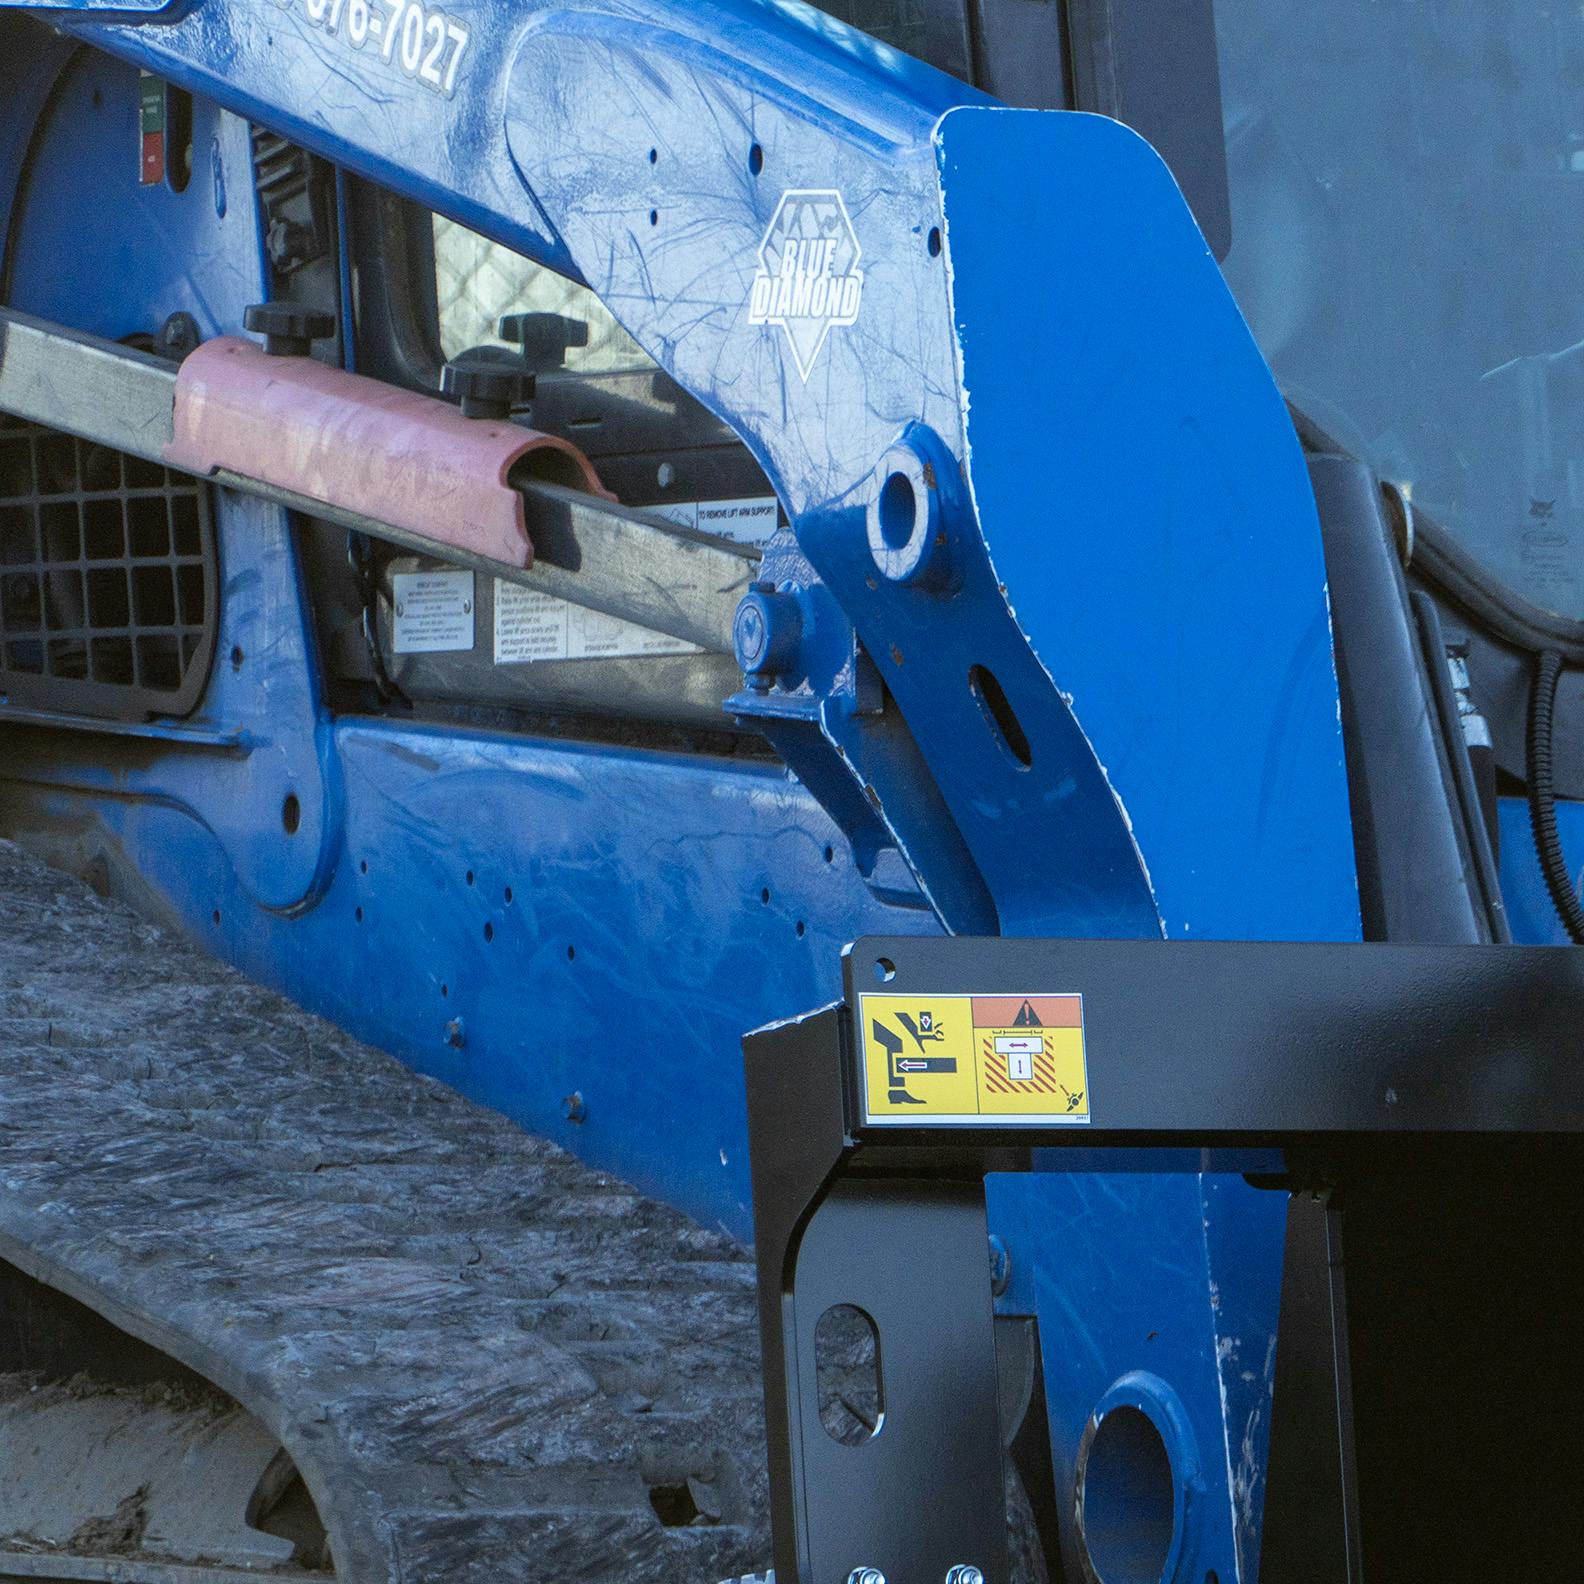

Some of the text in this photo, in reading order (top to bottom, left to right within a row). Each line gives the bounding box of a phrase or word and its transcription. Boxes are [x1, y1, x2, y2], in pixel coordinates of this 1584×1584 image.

[307, 0, 469, 91] 6-7027
[781, 239, 838, 279] BLUE
[753, 276, 860, 318] DIAMOND
